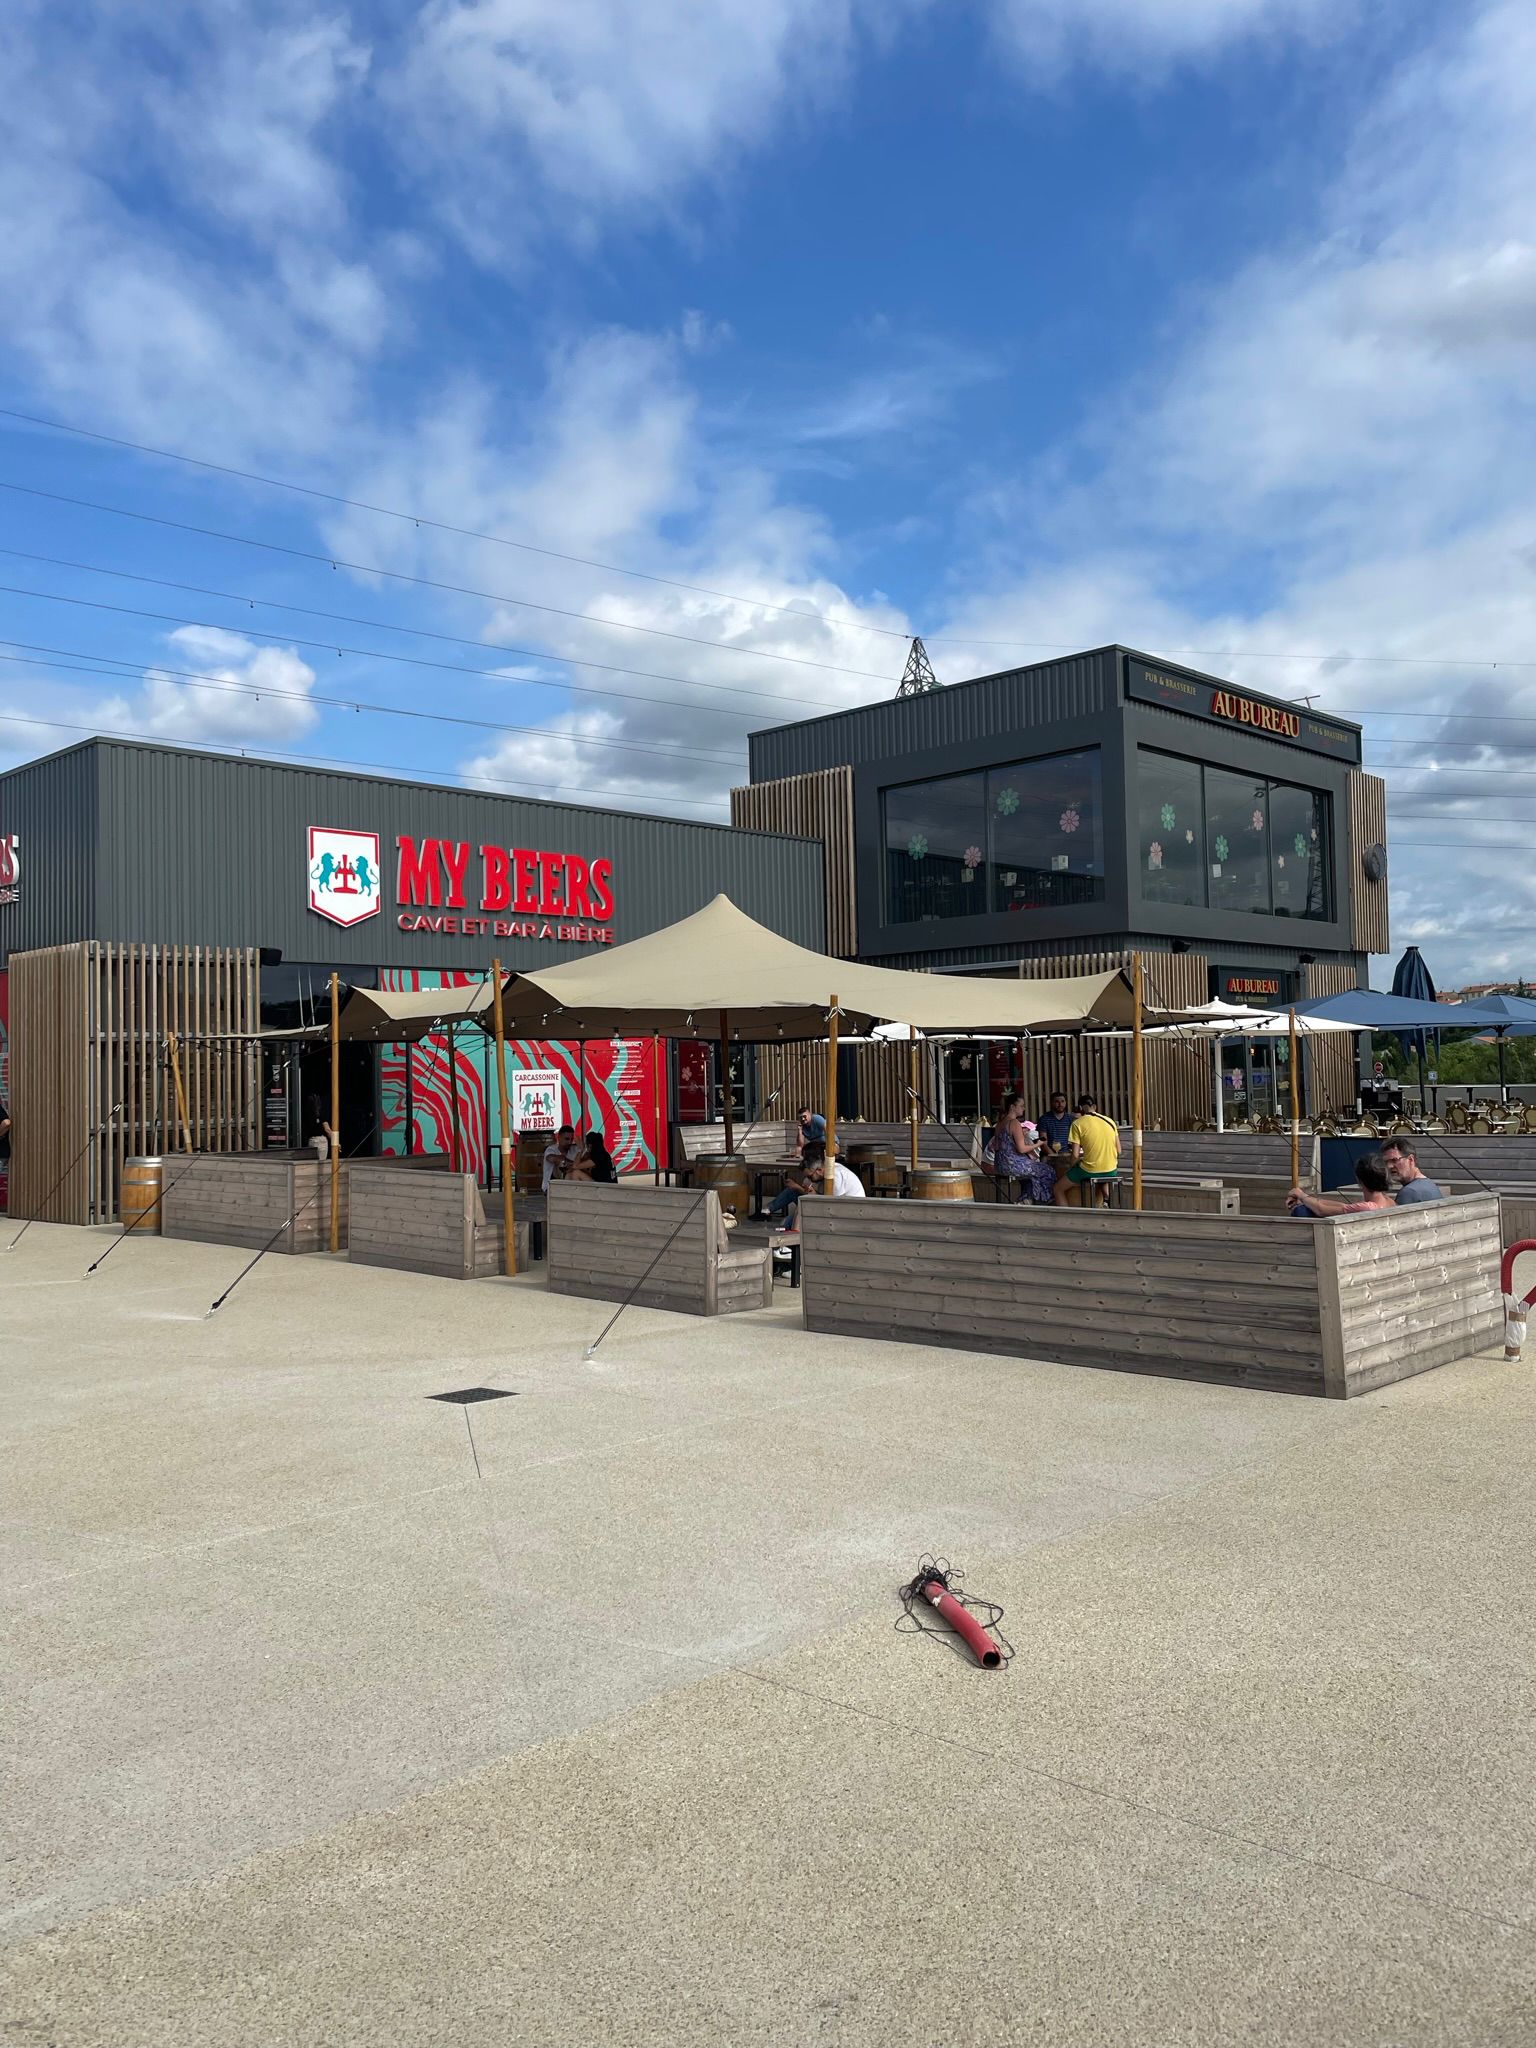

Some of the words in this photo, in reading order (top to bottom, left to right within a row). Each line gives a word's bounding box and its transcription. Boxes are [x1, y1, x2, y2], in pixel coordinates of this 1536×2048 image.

[1145, 672, 1158, 684] PUB
[1159, 676, 1165, 686] &
[1166, 678, 1197, 696] BRASSERIE
[1212, 690, 1237, 719] AU
[1239, 697, 1300, 738] BUREAU
[396, 836, 469, 907] MY
[479, 844, 615, 922] BEERS
[397, 913, 458, 934] CAVE
[462, 918, 490, 935] ET
[494, 920, 538, 937] BAR
[538, 919, 556, 940] À
[557, 922, 614, 943] BIÈRE
[1230, 978, 1243, 992] AU
[1244, 979, 1278, 993] BUREAU
[514, 1073, 560, 1082] CARCASSONNE
[521, 1117, 532, 1129] MY
[533, 1116, 555, 1128] BEERS
